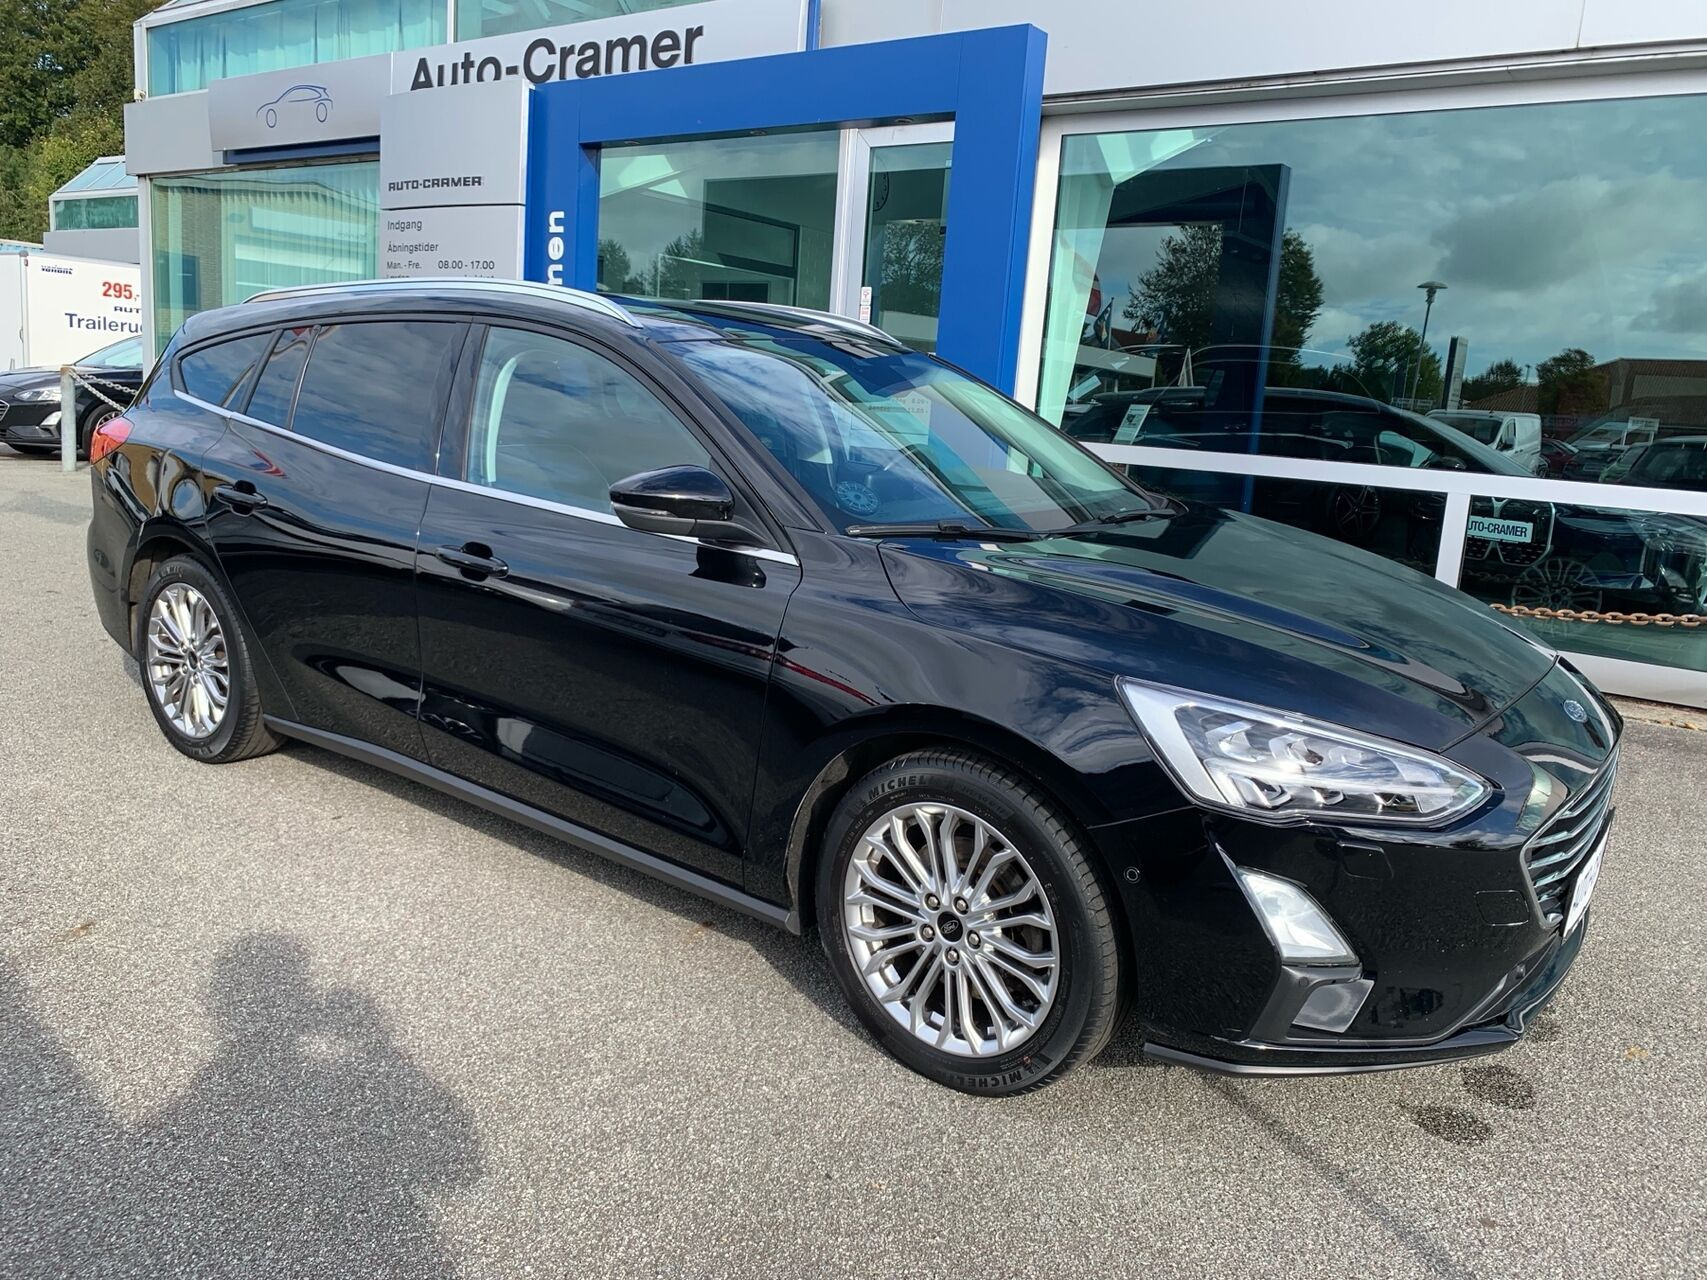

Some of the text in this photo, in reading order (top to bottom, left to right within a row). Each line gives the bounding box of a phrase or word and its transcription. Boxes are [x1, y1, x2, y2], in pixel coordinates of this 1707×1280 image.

[410, 25, 704, 91] Auto-Cramer
[387, 220, 423, 232] Indgang
[387, 241, 439, 254] Åbningstider
[438, 260, 463, 270] 08.00
[471, 260, 495, 270] 17.00
[65, 312, 142, 333] Traileru
